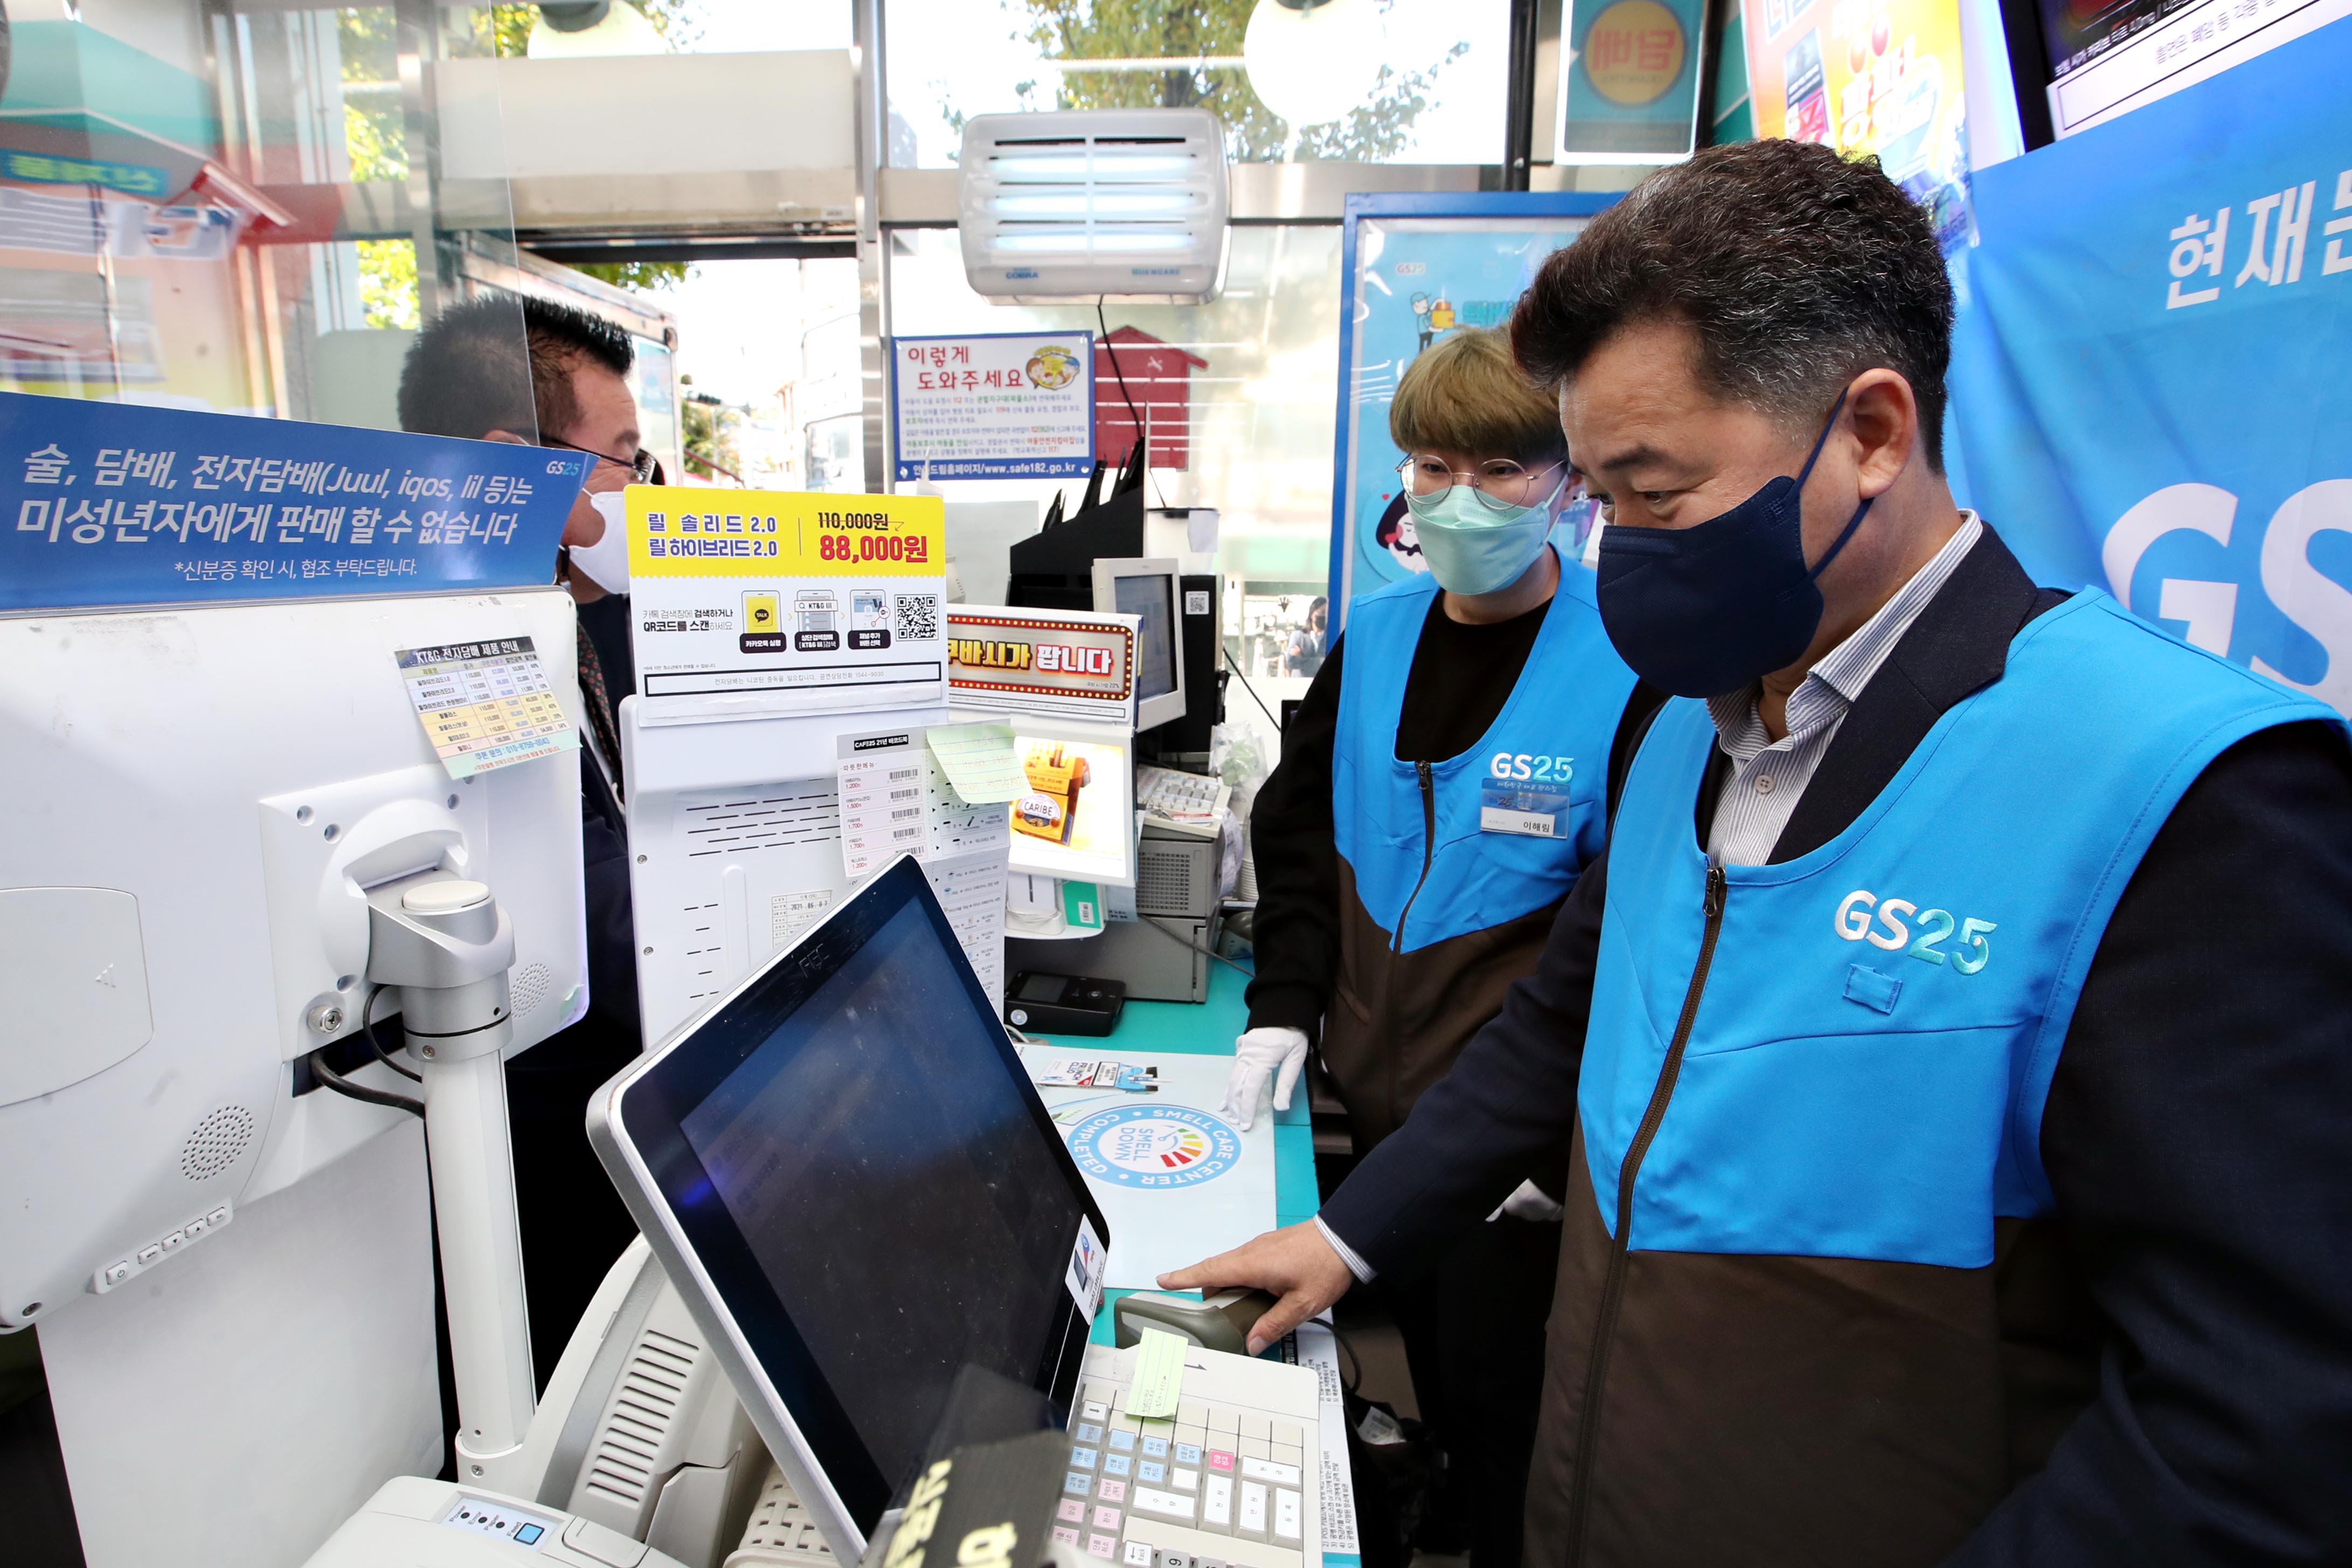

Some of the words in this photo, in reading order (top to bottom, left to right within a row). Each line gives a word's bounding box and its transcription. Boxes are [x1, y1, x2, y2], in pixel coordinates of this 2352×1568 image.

[2217, 12, 2231, 31] 등
[908, 346, 970, 368] 이렇게
[917, 369, 1025, 391] 도와주세요
[24, 444, 77, 485] 술,
[95, 449, 178, 489] 담배,
[192, 455, 389, 498] 전자담배(Juul,
[398, 470, 453, 502] iqos,
[461, 474, 485, 499] lil
[485, 475, 533, 505] 등)는
[546, 460, 580, 476] GS25
[17, 496, 272, 544] 미성년자에게
[277, 505, 347, 543] 판매
[349, 506, 382, 544] 할
[384, 509, 412, 544] 수
[418, 509, 517, 545] 없습니다
[647, 512, 666, 533] 릴
[750, 516, 777, 534] 2.0
[817, 512, 890, 531] 110,000원
[649, 538, 667, 557] 릴
[669, 538, 752, 557] 하이브리드
[753, 540, 779, 557] 2.0
[820, 535, 929, 564] 88,000원
[240, 559, 275, 580] 확인
[277, 559, 297, 579] 시,
[302, 559, 331, 579] 협조
[334, 558, 417, 576] 부탁드립니다.
[643, 610, 659, 619] 카톡
[661, 610, 693, 619] 검색창에
[695, 609, 733, 618] 검색하거나
[643, 621, 687, 632] QR코드를
[690, 621, 733, 632] 스캔하세요
[415, 649, 440, 664] KT&G
[443, 645, 480, 660] 전자담배
[481, 642, 500, 655] 제품
[501, 640, 520, 653] 안내
[1036, 643, 1112, 675] 팝니다
[715, 677, 743, 685] 전자담배는
[855, 740, 876, 748] CAFE25
[1490, 752, 1574, 783] GS25
[1024, 802, 1053, 816] CARIBE
[1523, 821, 1550, 832] 이해림
[1834, 890, 1997, 976] GS25
[1072, 1062, 1088, 1080] FRENCH
[1152, 1109, 1210, 1130] SMELL
[1074, 1114, 1120, 1174] COMPLETED
[1114, 1128, 1131, 1161] DOWN
[1133, 1129, 1153, 1161] SMELL
[1213, 1130, 1235, 1159] CARE
[1141, 1160, 1224, 1185] CENTER
[449, 1505, 466, 1522] Power
[468, 1511, 482, 1525] Error
[484, 1515, 500, 1530] Paper
[506, 1522, 522, 1537] Feed
